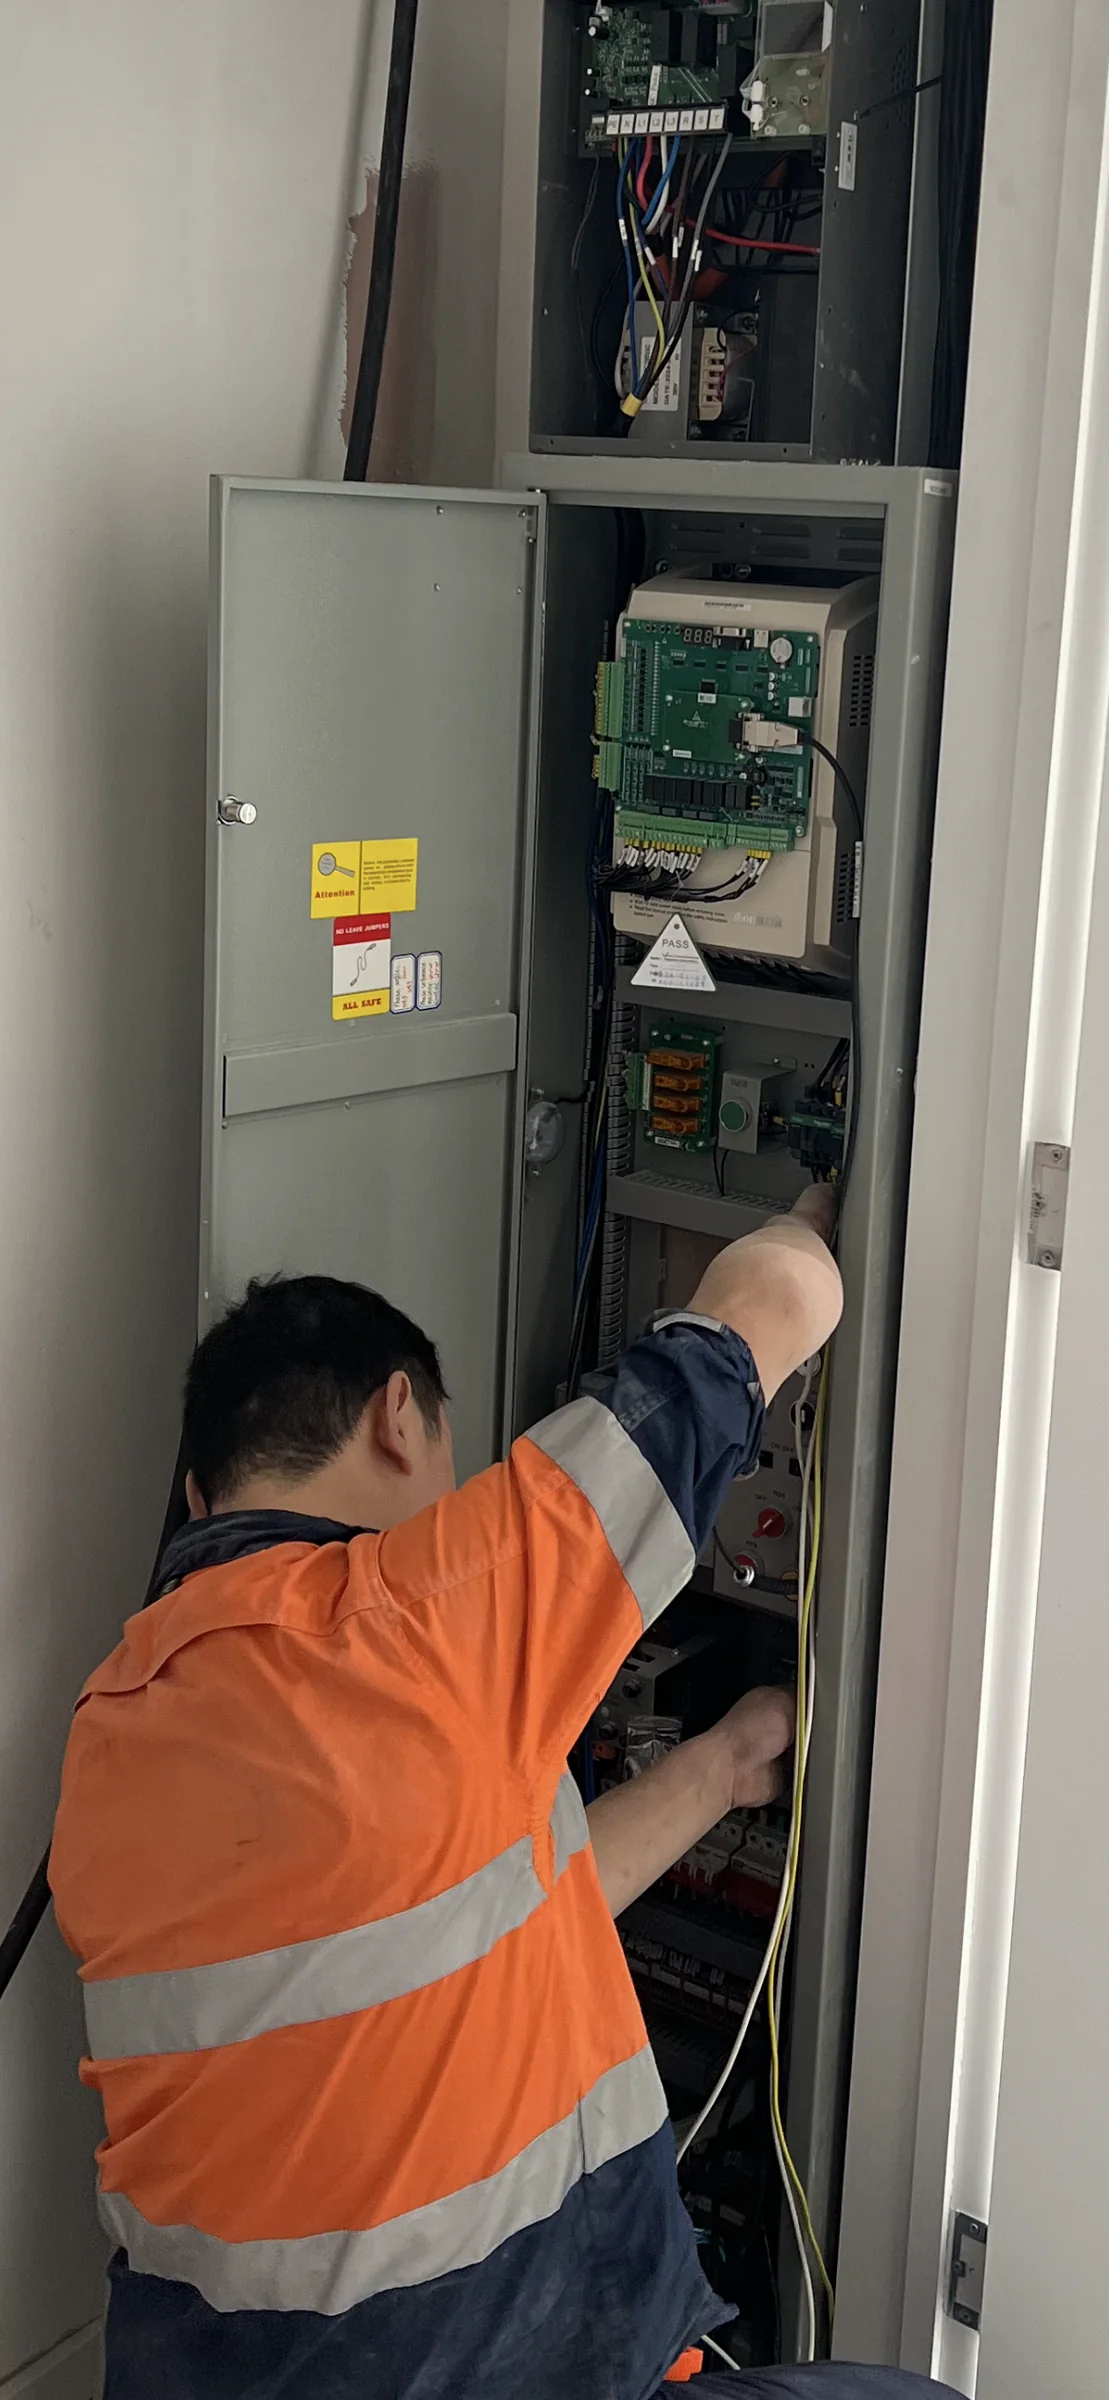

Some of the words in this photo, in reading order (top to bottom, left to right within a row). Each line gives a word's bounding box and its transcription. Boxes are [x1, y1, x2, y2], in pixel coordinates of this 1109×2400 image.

[637, 119, 646, 128] L1
[651, 118, 660, 127] L2
[666, 117, 676, 126] L3
[682, 116, 689, 125] R
[698, 115, 704, 124] S
[314, 889, 355, 899] Attention
[345, 925, 363, 934] LEAVE
[364, 923, 389, 932] JUMPERS
[661, 938, 689, 949] PASS
[342, 1001, 359, 1011] ALL
[361, 997, 382, 1007] SAFE
